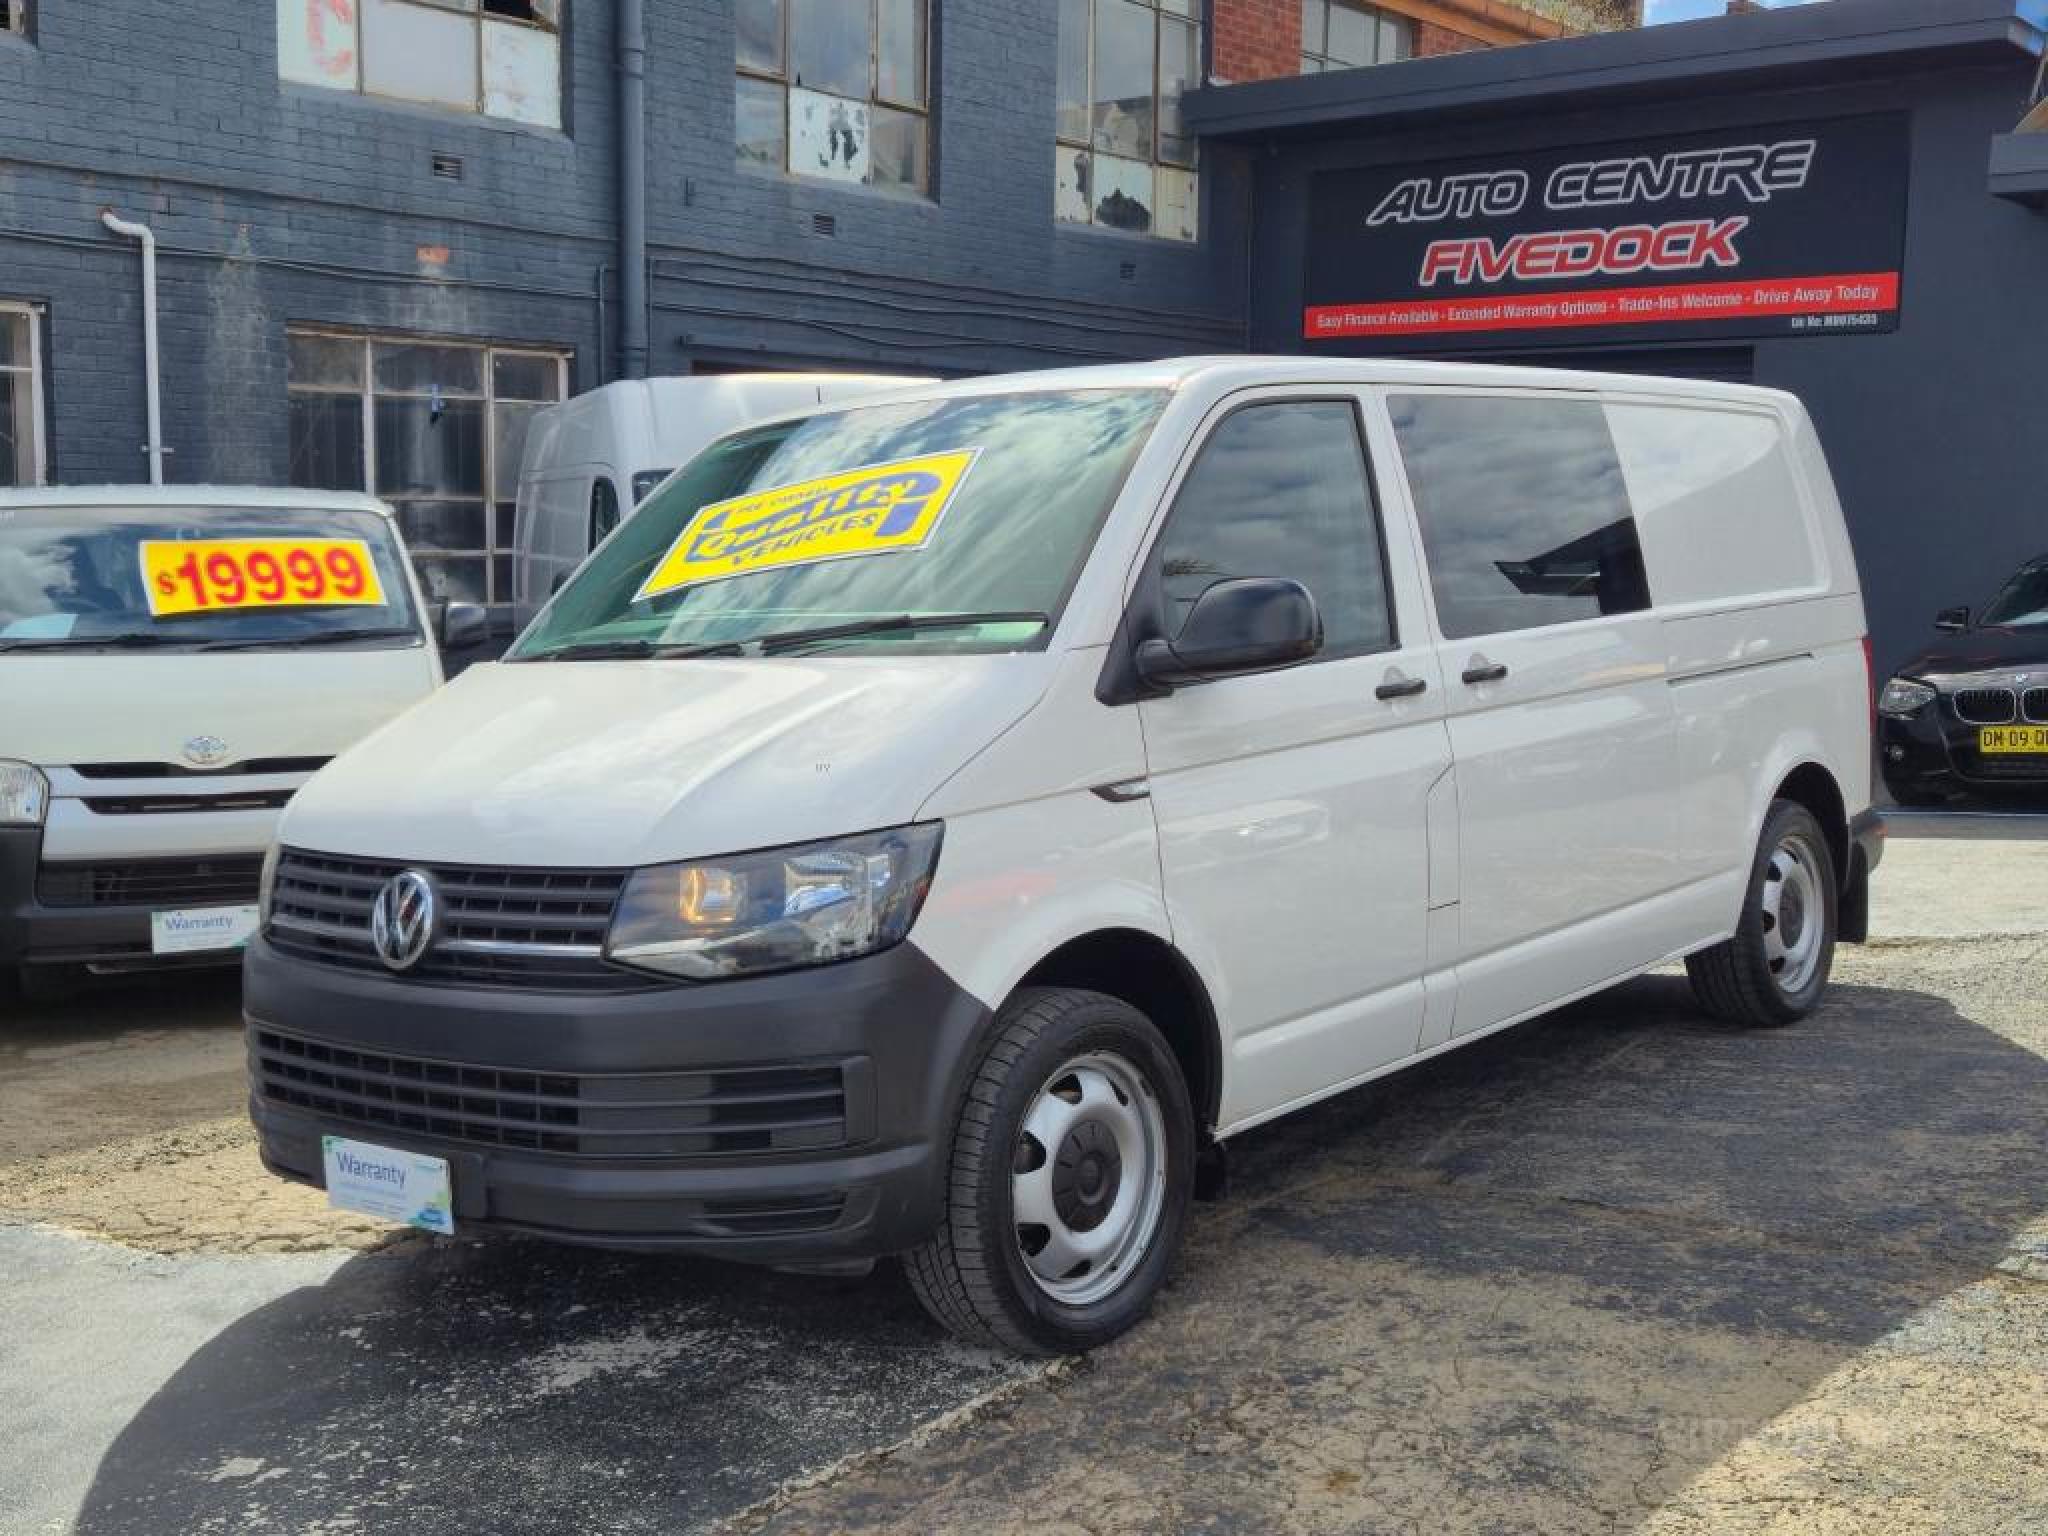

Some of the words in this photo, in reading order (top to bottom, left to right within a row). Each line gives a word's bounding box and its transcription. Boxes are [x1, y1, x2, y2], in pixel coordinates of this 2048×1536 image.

[1366, 170, 1528, 226] AUTO
[1544, 139, 1816, 209] CENTRE
[1419, 215, 1749, 286] FIVEDOCK
[1317, 314, 1342, 328] Easy
[1345, 312, 1386, 325] Finance
[1389, 309, 1439, 323] Available
[1448, 306, 1501, 321] Extended
[1503, 303, 1557, 319] Warranty
[1560, 301, 1607, 317] Options
[1619, 294, 1678, 311] Trade-Ins
[1681, 293, 1743, 309] Welcome
[1754, 288, 1789, 304] Drive
[1793, 286, 1833, 303] Away
[1836, 283, 1879, 301] Today
[732, 512, 879, 564] VEHICLES
[157, 547, 366, 607] $19999
[165, 915, 233, 931] Warranty
[335, 1150, 409, 1189] Warranty
